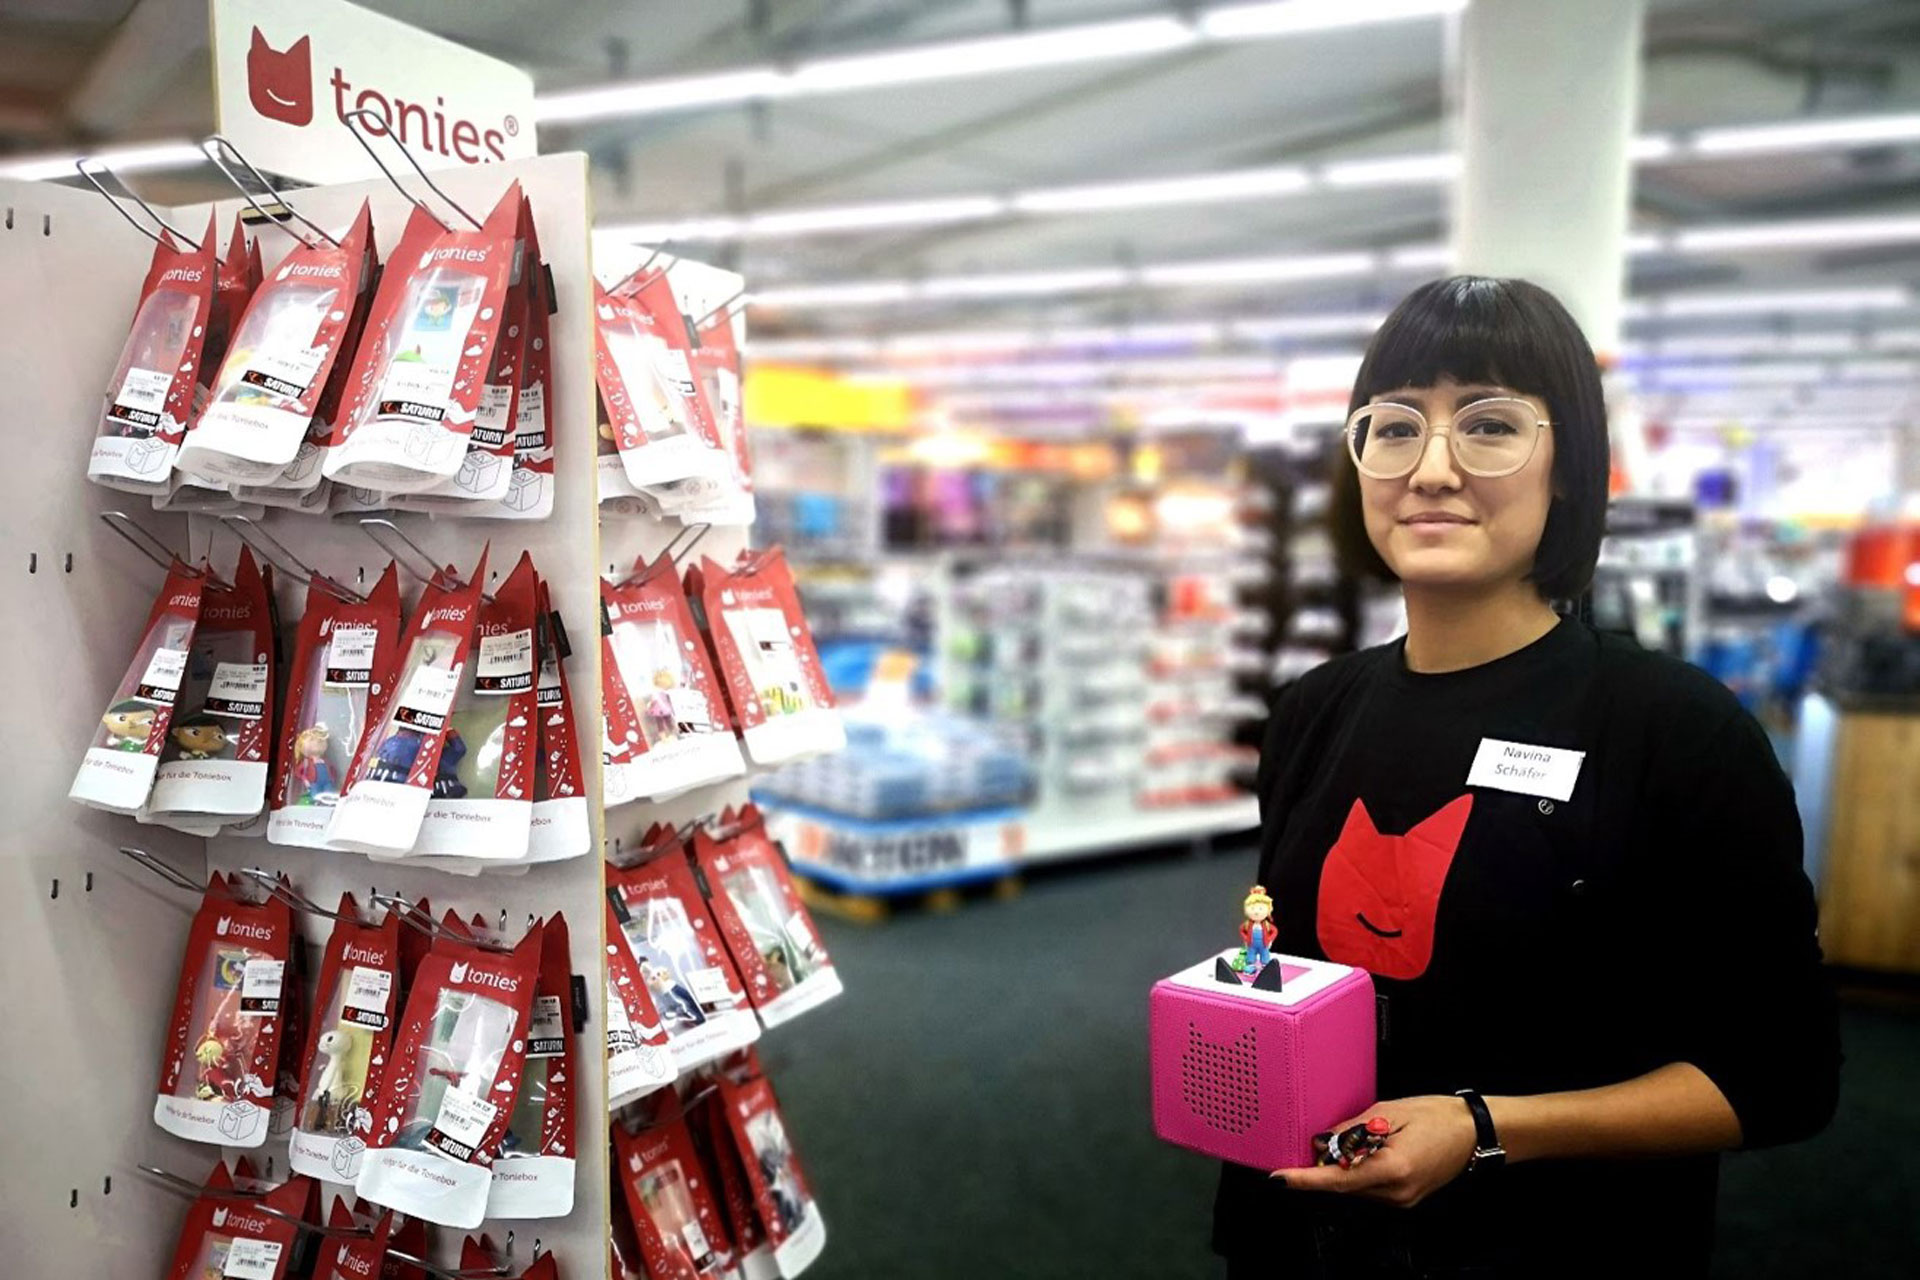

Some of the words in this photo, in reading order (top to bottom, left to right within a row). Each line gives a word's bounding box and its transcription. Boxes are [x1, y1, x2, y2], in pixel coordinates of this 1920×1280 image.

[162, 267, 202, 283] onies
[292, 263, 342, 278] tonies
[263, 377, 302, 397] SATURN
[128, 410, 158, 426] SATURN
[399, 402, 443, 419] SATURN
[471, 428, 503, 444] ATURN
[515, 432, 544, 447] ATURN
[170, 592, 199, 607] onies
[621, 599, 664, 615] tonies
[204, 606, 250, 619] tonies
[476, 619, 509, 635] nies
[500, 675, 531, 689] SATURN
[227, 702, 261, 714] SATURN
[1503, 746, 1552, 763] Navina
[192, 771, 232, 782] Toniebox
[1494, 763, 1548, 780] Schäfer
[434, 810, 447, 818] die
[451, 812, 492, 823] Toniebox
[531, 818, 552, 826] ebox
[627, 878, 668, 896] tonies
[229, 921, 272, 941] tonies
[468, 968, 517, 992] tonies
[533, 1039, 563, 1052] SATURN
[440, 1136, 472, 1160] SATURN
[499, 1172, 537, 1182] Toniebox
[226, 1213, 267, 1234] tonies
